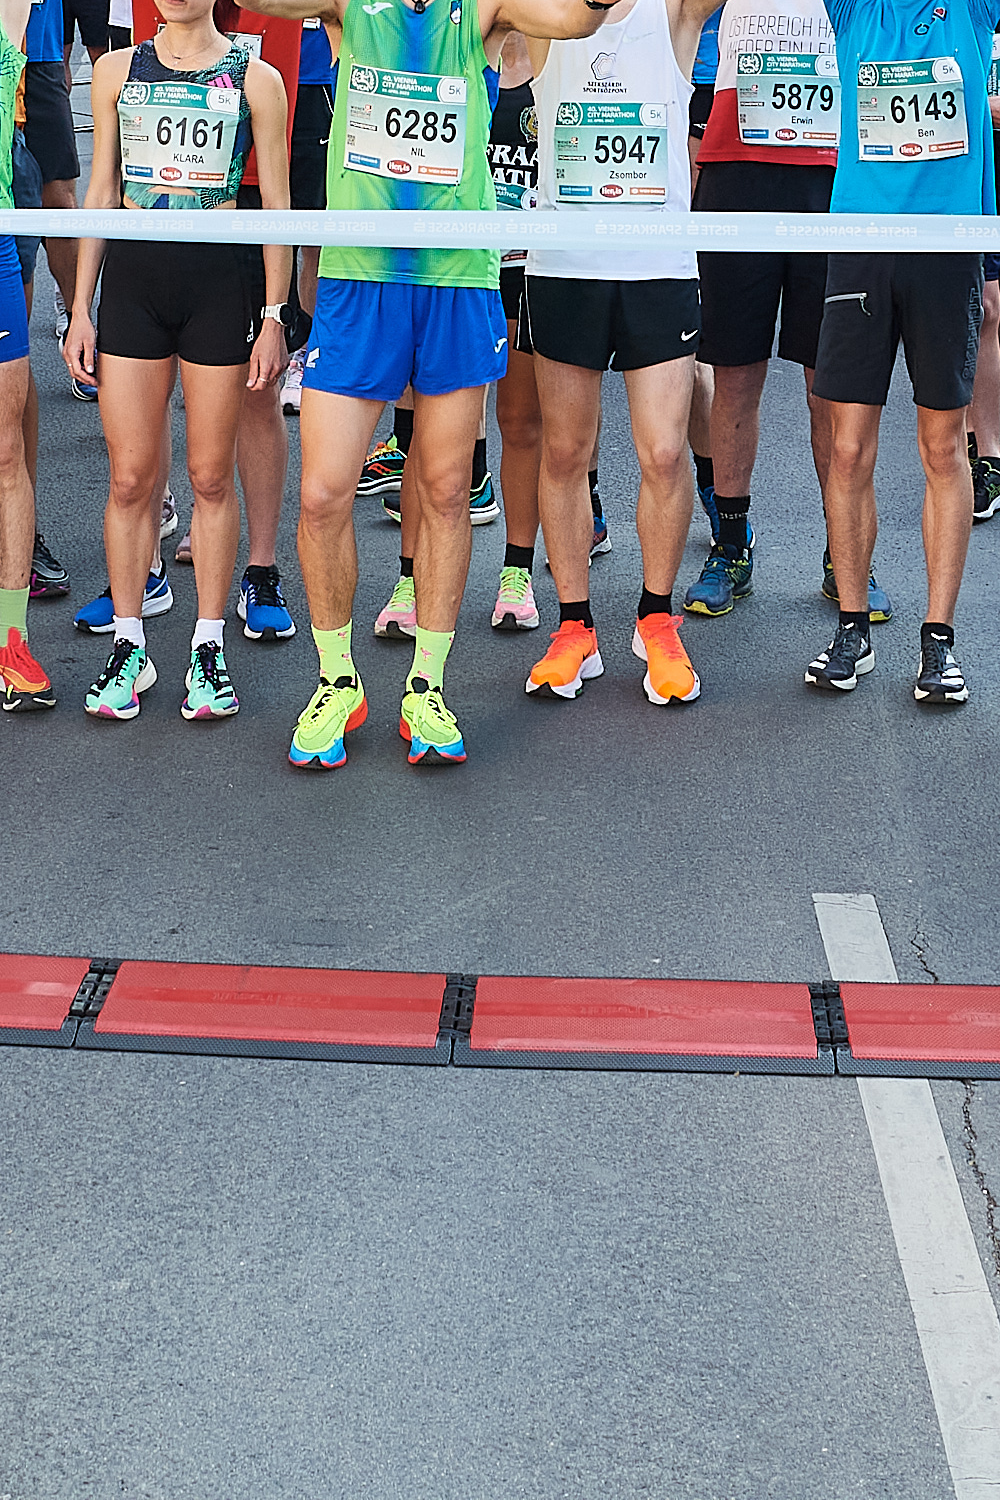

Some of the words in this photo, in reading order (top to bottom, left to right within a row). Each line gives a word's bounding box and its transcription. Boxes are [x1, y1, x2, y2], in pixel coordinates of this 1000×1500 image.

[728, 15, 812, 38] ÖSTERREICH
[243, 42, 254, 51] 5K
[894, 70, 928, 78] MARATHON
[942, 65, 954, 74] 5K
[394, 76, 417, 85] VIENNA
[382, 81, 396, 89] CITY
[396, 82, 433, 93] MARATHON
[448, 85, 461, 95] 5K
[218, 95, 231, 105] 5K
[772, 84, 833, 111] 5879
[891, 90, 957, 123] 6143
[650, 110, 662, 118] 5K
[791, 116, 813, 124] Erwin
[386, 108, 457, 143] 6285
[157, 116, 224, 150] 6161
[918, 129, 935, 137] Ben
[410, 147, 426, 157] NIL
[594, 135, 660, 164] 5947
[173, 154, 204, 164] KLARA
[493, 168, 532, 189] ATI
[609, 171, 647, 179] Zsombor
